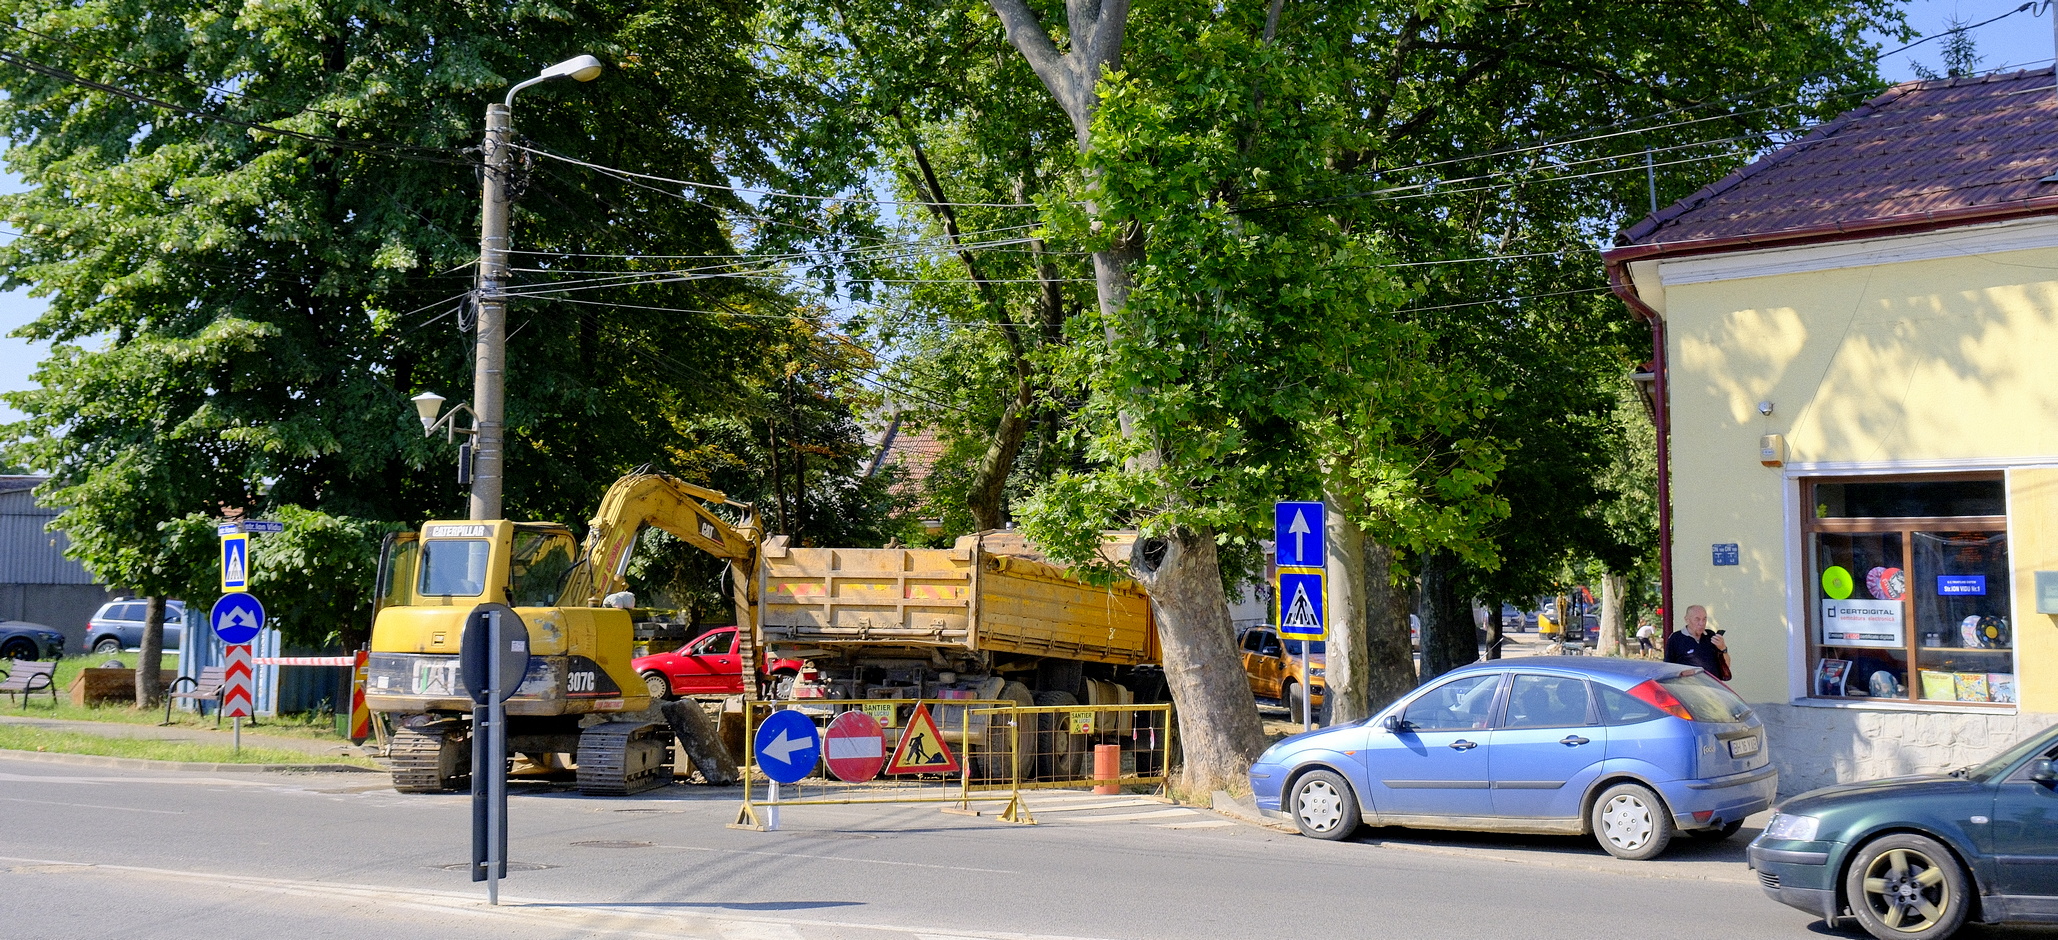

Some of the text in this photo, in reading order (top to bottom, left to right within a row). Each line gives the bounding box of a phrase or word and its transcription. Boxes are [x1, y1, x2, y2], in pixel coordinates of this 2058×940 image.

[432, 526, 485, 536] CATERPILLAR
[702, 522, 715, 539] CAT
[412, 660, 461, 696] CAT
[567, 671, 595, 692] 307C
